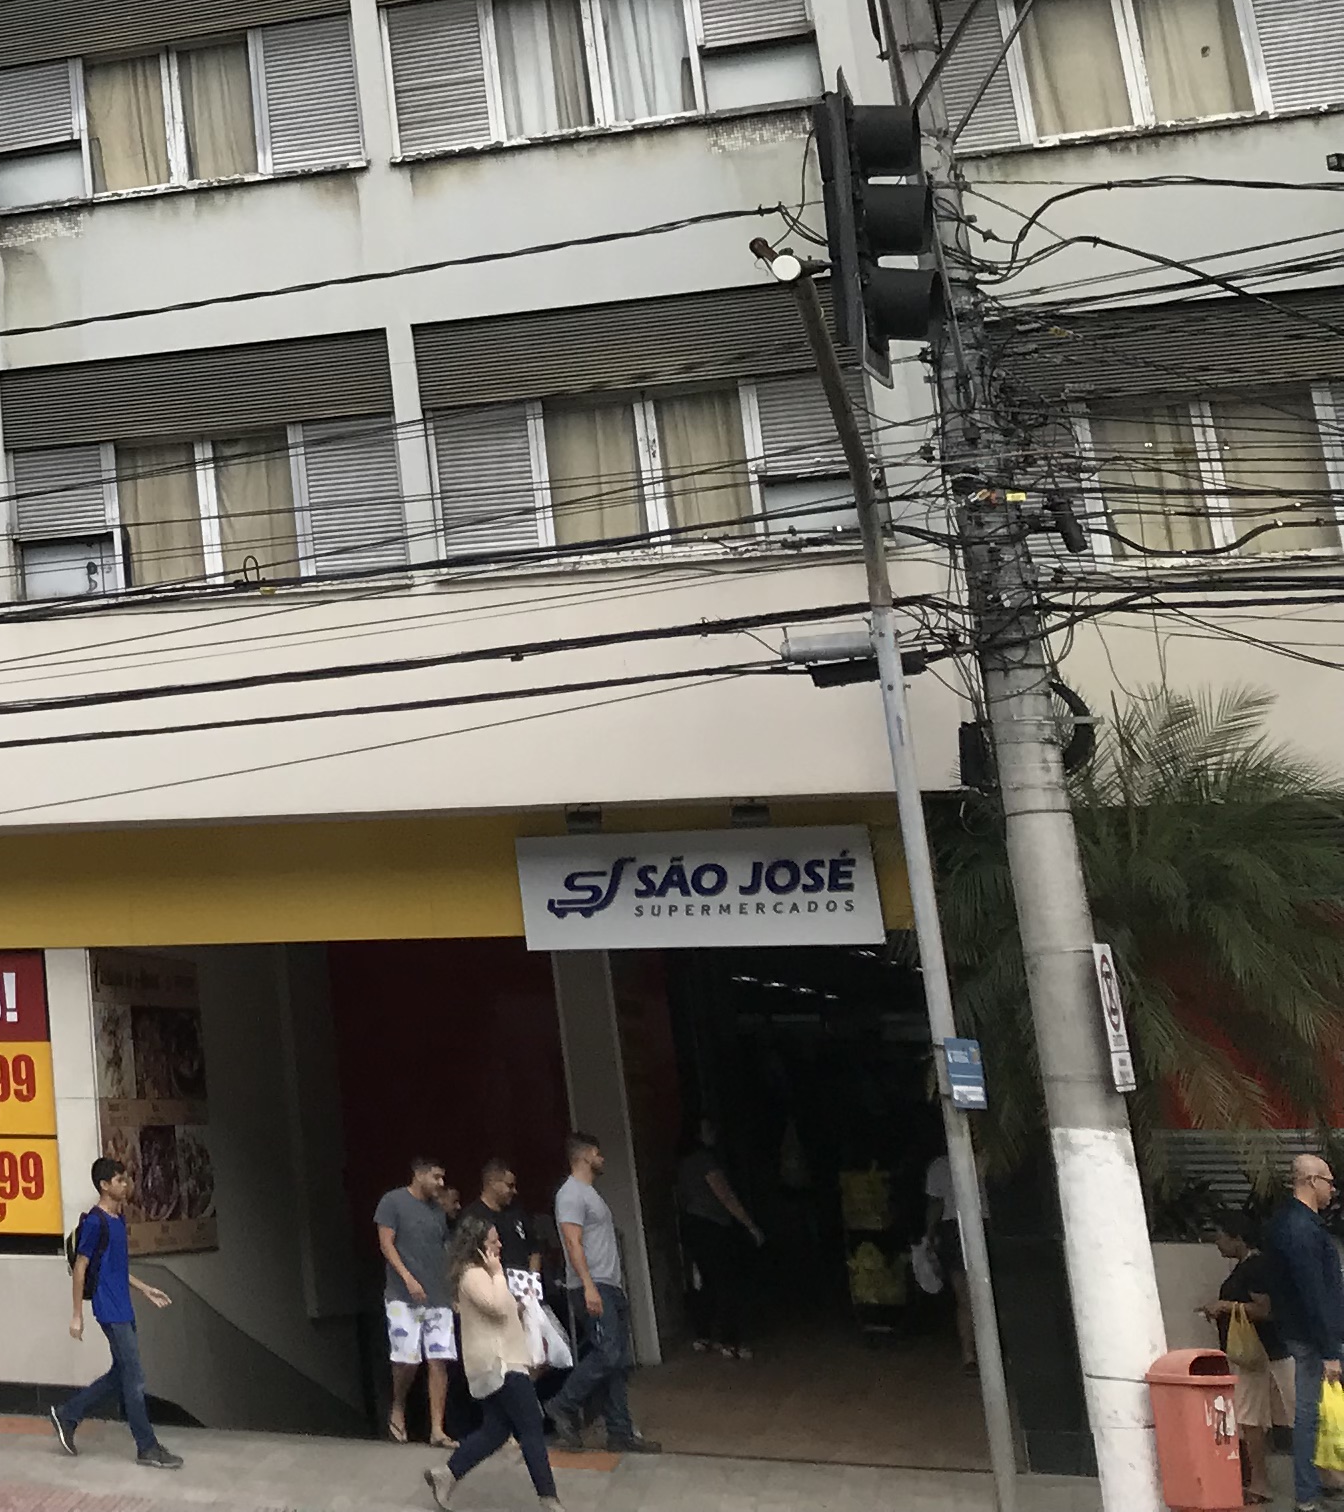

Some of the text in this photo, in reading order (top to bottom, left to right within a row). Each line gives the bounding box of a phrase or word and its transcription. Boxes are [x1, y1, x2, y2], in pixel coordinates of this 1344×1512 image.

[634, 856, 728, 898] SÃO
[738, 849, 857, 895] JOSÉ
[633, 899, 857, 917] SUPERMERCADOS
